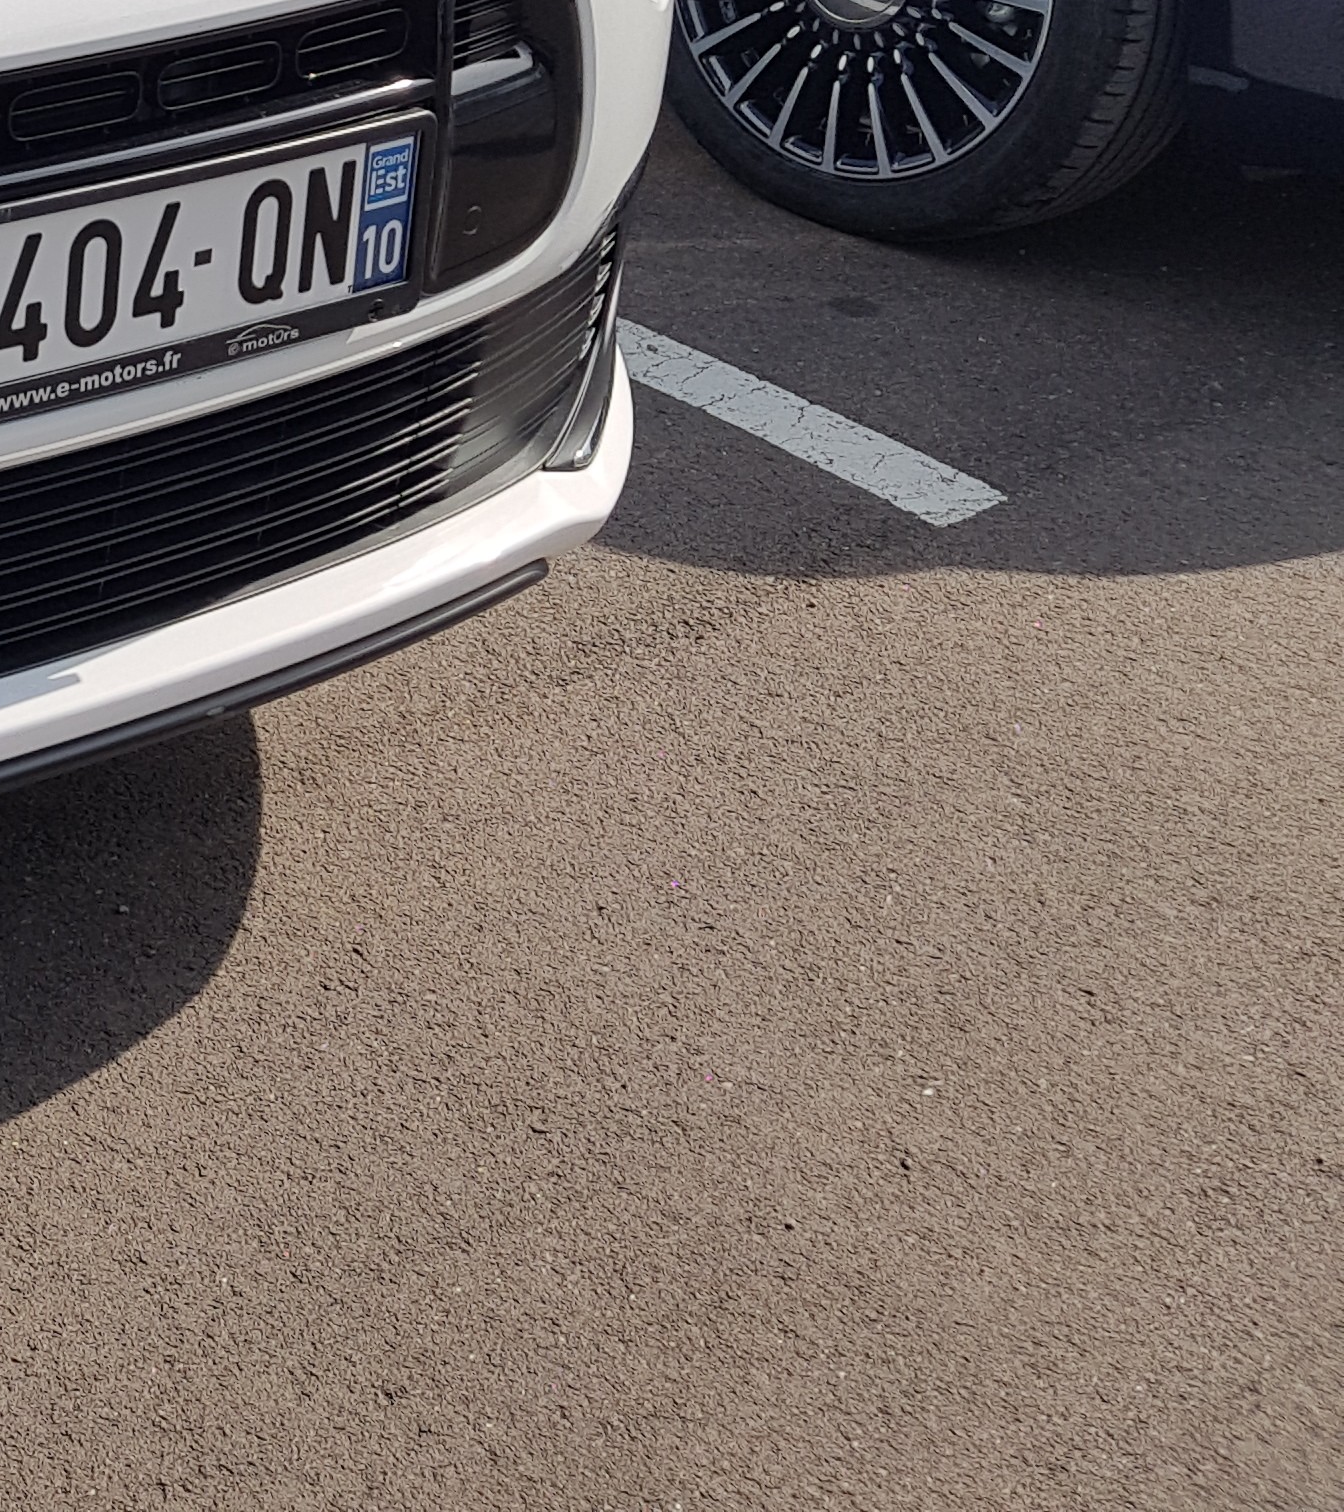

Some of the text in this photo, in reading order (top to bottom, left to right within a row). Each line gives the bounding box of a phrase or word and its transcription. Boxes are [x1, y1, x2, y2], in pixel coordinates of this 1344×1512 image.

[372, 148, 409, 169] Grand
[370, 165, 407, 196] Est
[362, 219, 403, 280] 10
